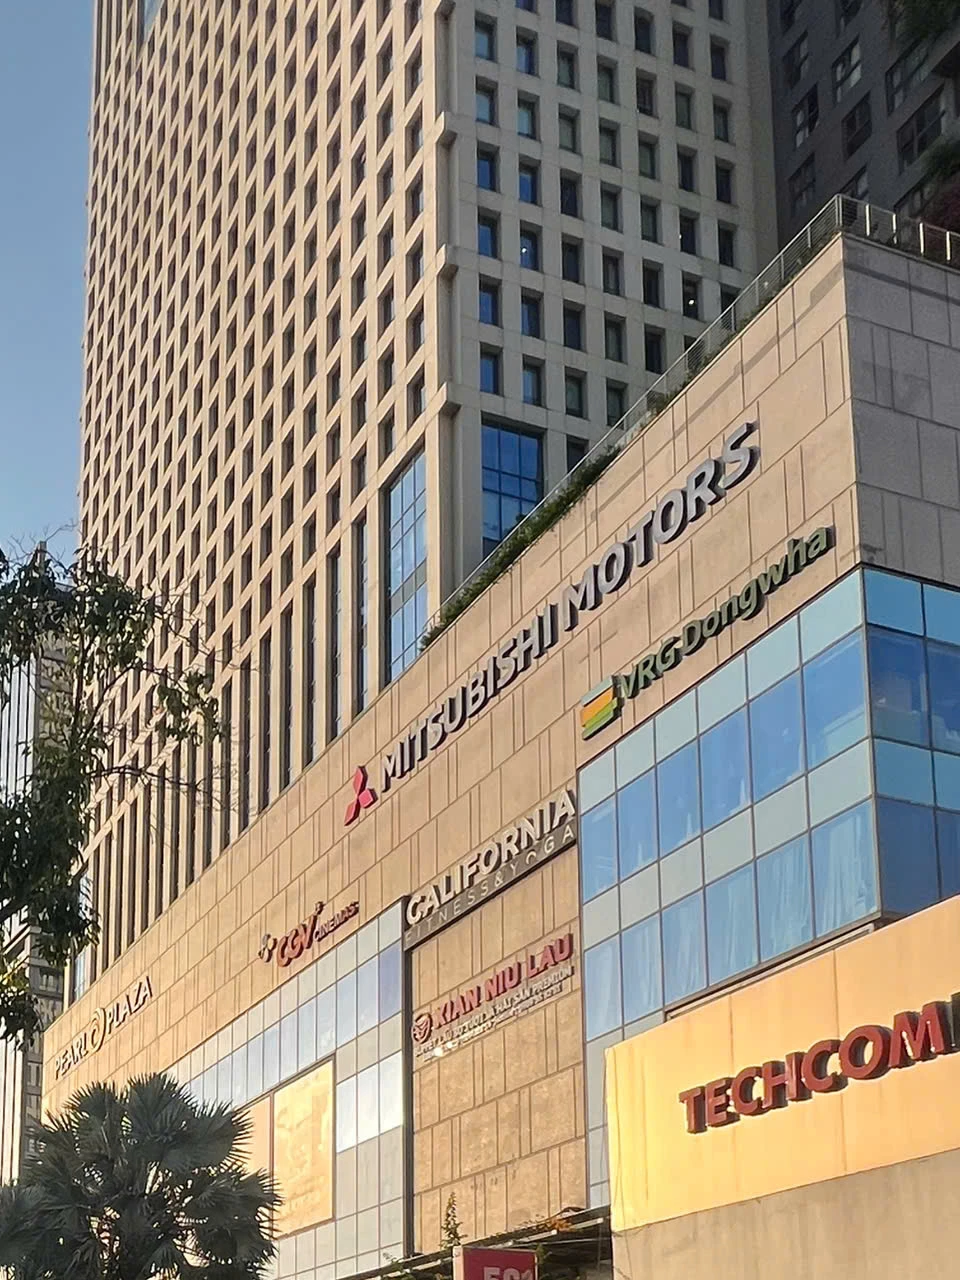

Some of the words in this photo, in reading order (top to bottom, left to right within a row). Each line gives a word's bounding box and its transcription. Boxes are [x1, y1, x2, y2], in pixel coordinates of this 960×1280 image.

[381, 603, 559, 791] MITSUBISHI
[563, 420, 761, 631] MOTORS
[406, 789, 577, 926] CALIFORNIA
[277, 914, 318, 968] CGV
[404, 882, 491, 944] FITNESS
[484, 961, 522, 1003] NIU
[527, 932, 574, 979] LAU
[54, 1032, 89, 1081] PEARL
[106, 975, 153, 1034] PLAZA
[679, 992, 960, 1134] TECHCOM
